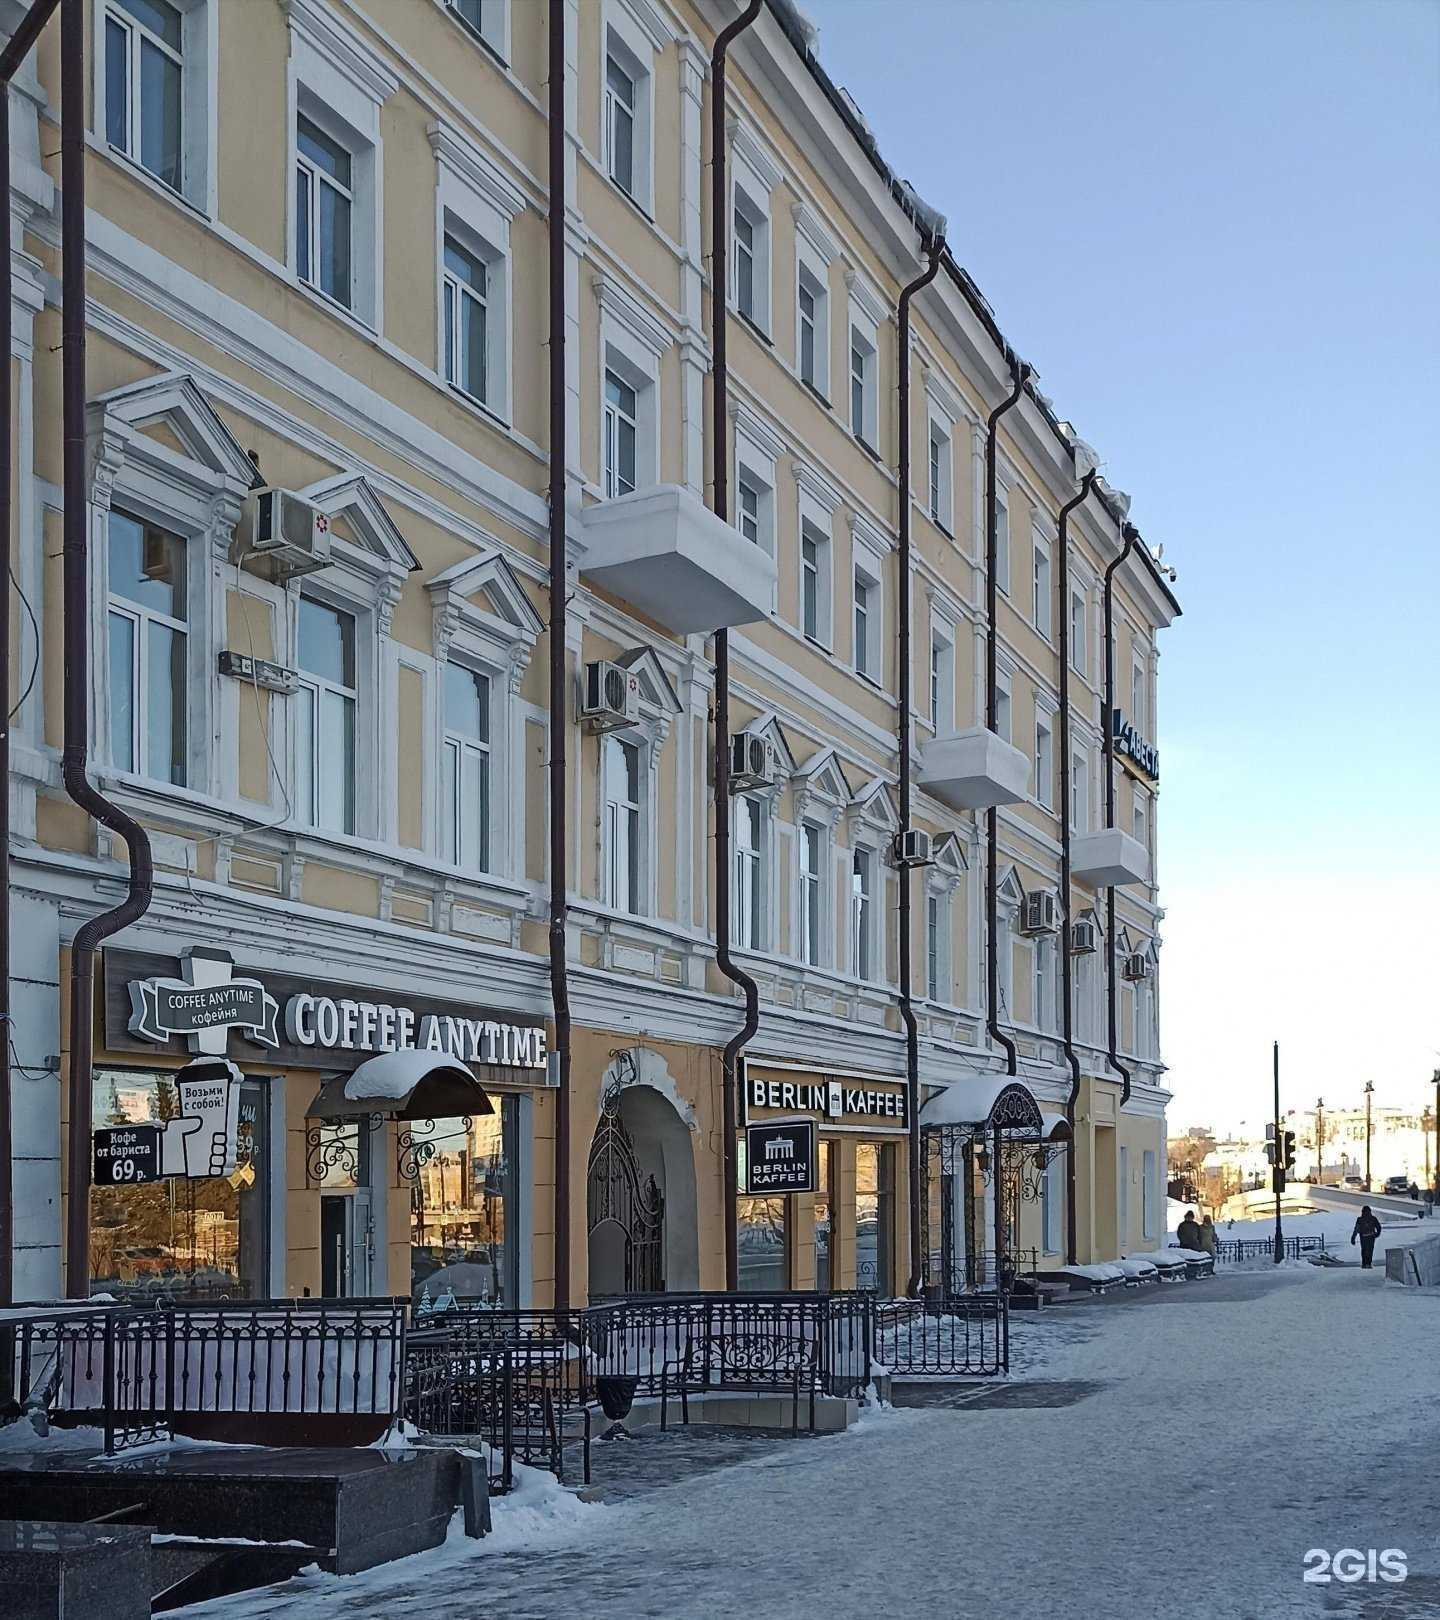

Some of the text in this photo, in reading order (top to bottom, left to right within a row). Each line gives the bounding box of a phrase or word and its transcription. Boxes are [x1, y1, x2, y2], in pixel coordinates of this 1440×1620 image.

[168, 989, 254, 1009] COFFEE ANYTIME
[191, 1007, 238, 1026] кофейня
[288, 993, 547, 1069] COFFEE ANYTIME
[184, 1087, 223, 1099] Возьми
[753, 1079, 905, 1117] BERLIN KAFFEE
[184, 1098, 224, 1110] с собой!
[110, 1131, 137, 1146] Кофе
[96, 1143, 151, 1158] от бариста
[112, 1159, 147, 1181] 69 р.
[752, 1162, 807, 1174] BERLIN
[752, 1172, 806, 1184] KAFFEE
